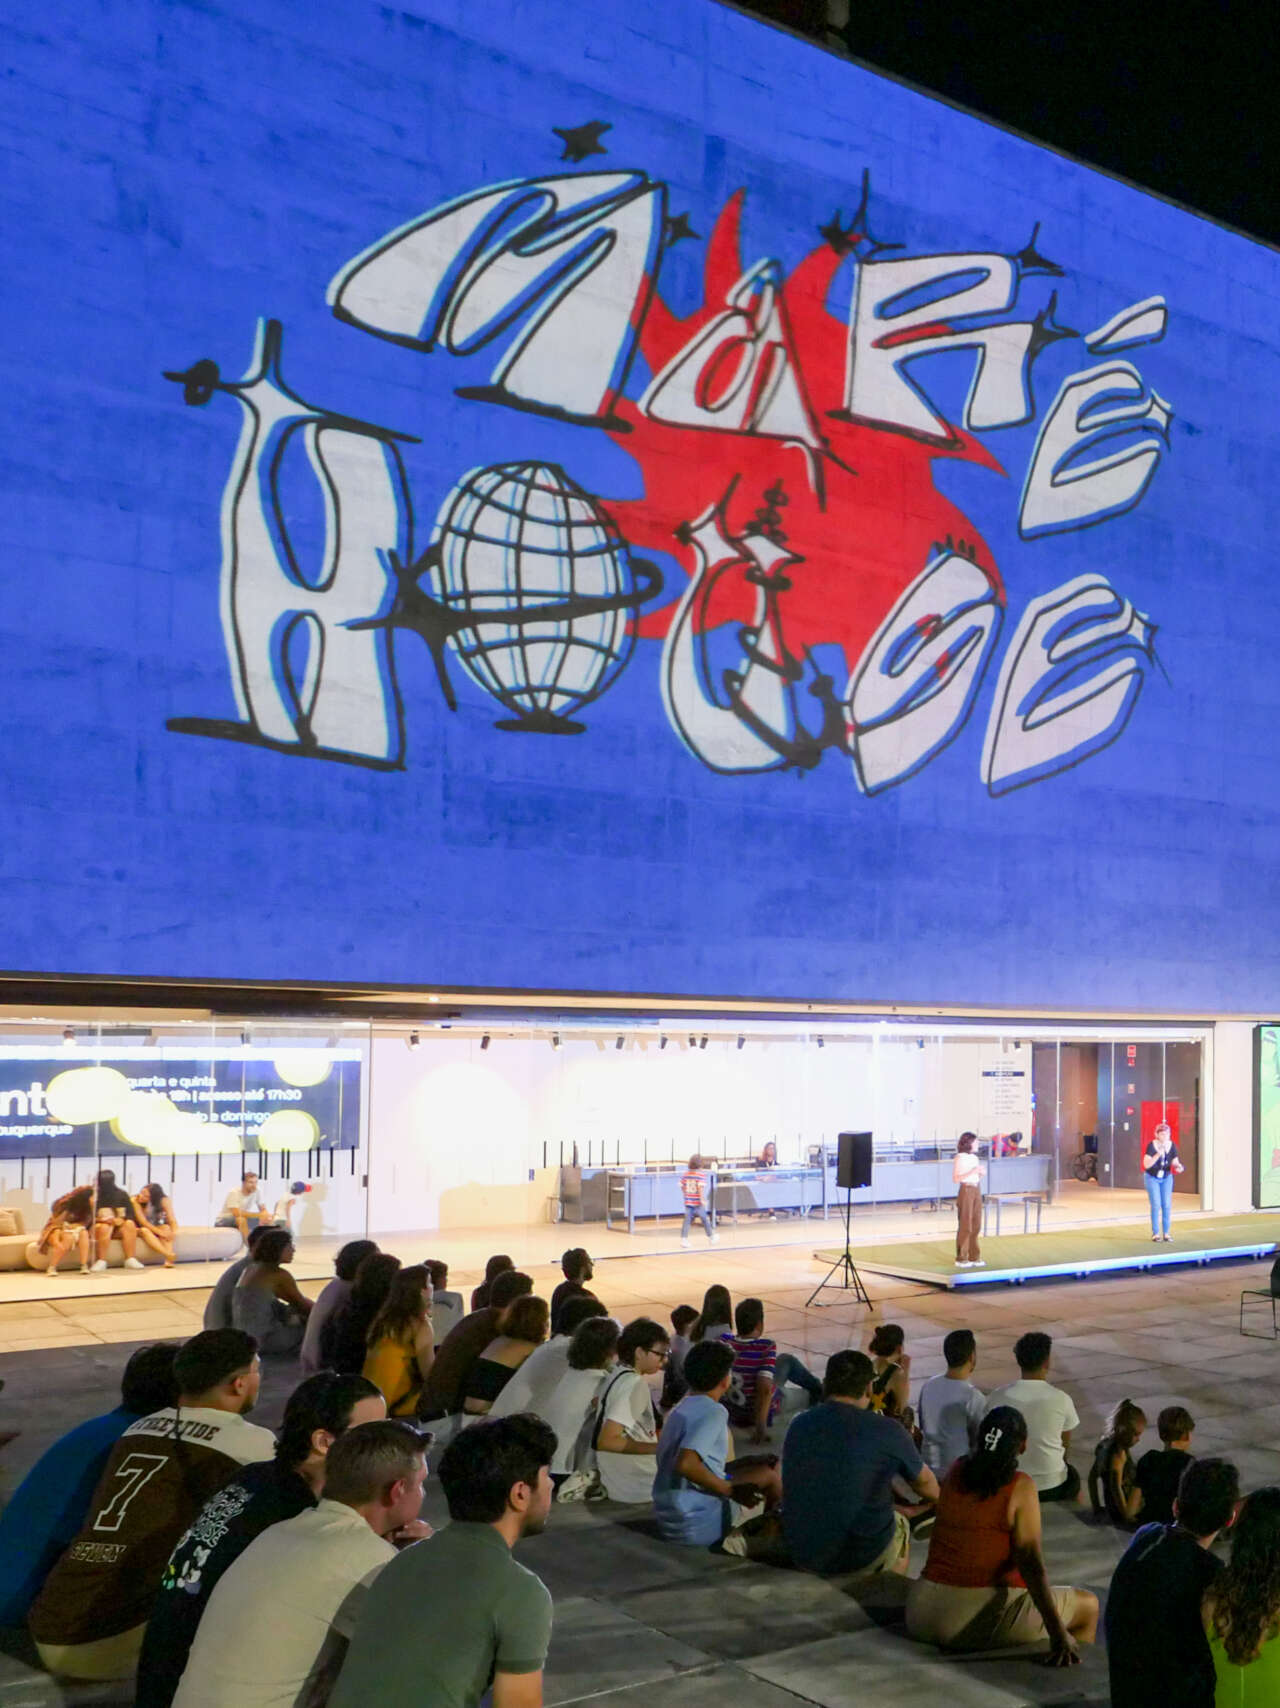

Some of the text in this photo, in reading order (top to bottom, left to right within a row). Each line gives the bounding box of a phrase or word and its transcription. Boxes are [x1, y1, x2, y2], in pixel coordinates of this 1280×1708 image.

[179, 1076, 217, 1089] quinta
[266, 1088, 302, 1101] 17h30
[221, 1111, 272, 1124] domingo
[93, 1453, 169, 1531] 7
